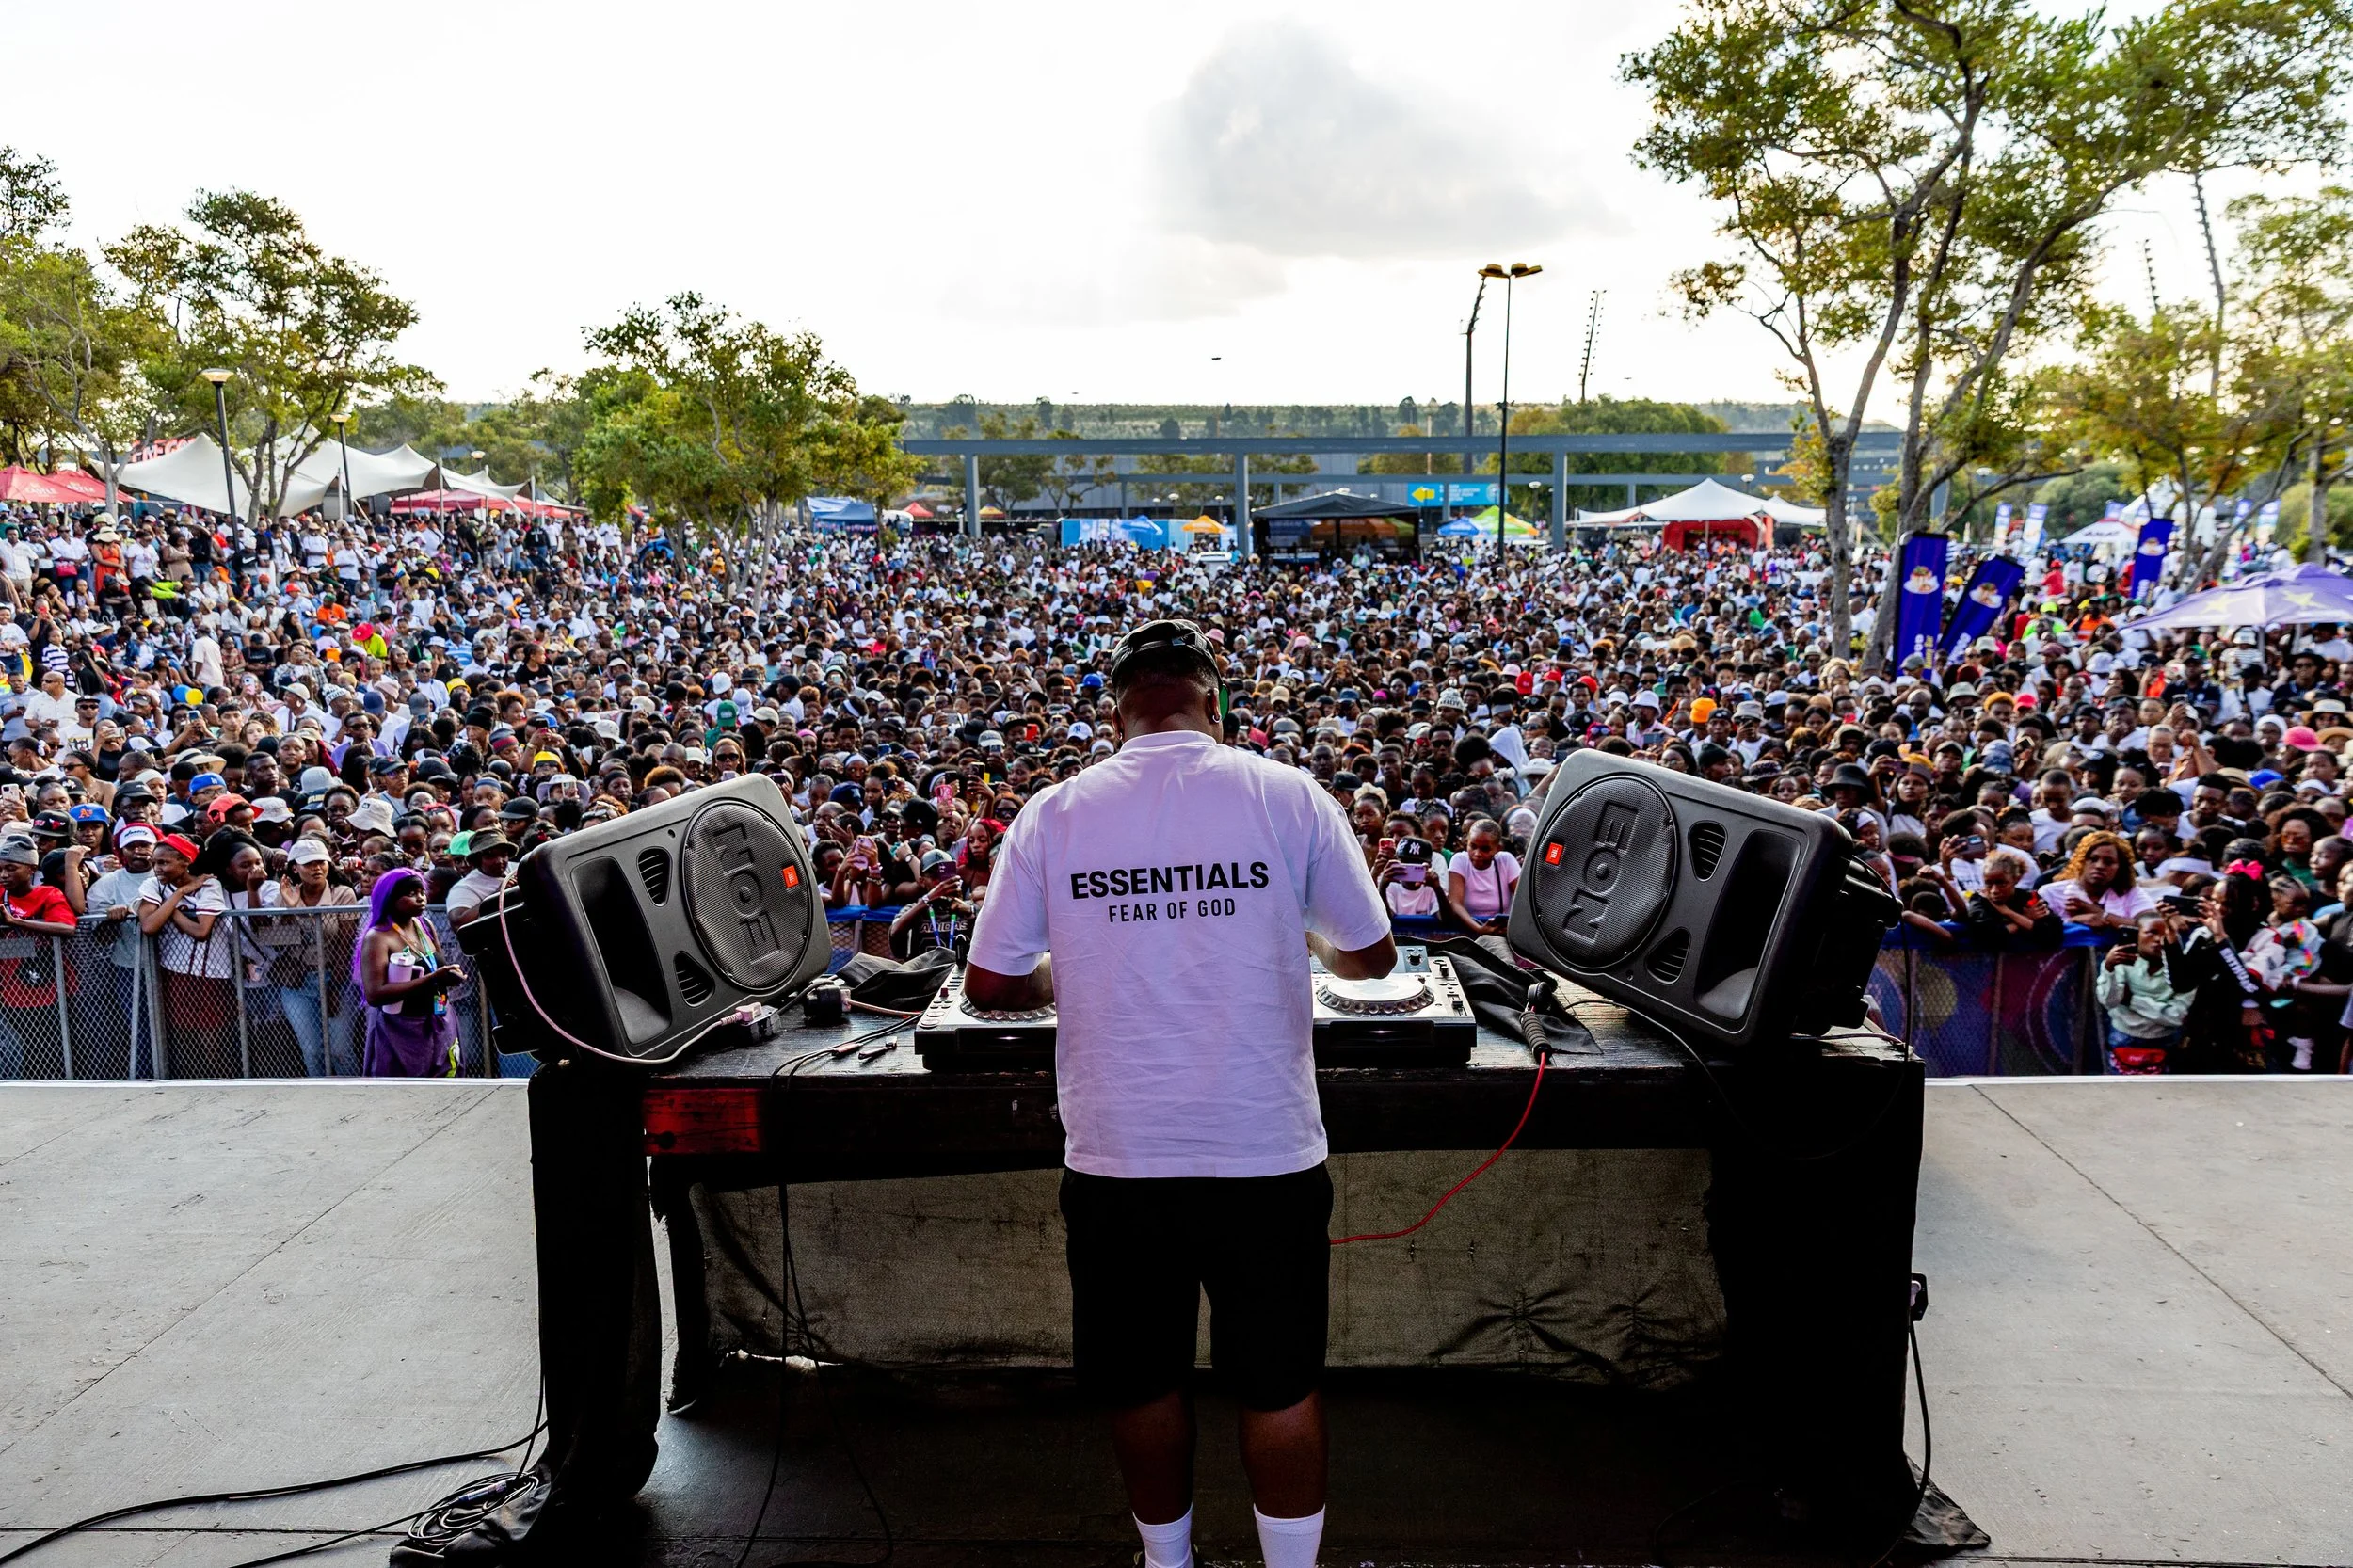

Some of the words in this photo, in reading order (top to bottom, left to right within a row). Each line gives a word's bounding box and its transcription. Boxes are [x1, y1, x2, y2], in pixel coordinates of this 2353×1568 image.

[1408, 841, 1420, 855] NY
[1070, 861, 1270, 900] ESSENTIALS
[1562, 801, 1640, 946] EON
[712, 821, 782, 966] EON
[1109, 903, 1157, 923] FEAR
[1166, 901, 1188, 920] OF
[1197, 898, 1236, 918] GOD
